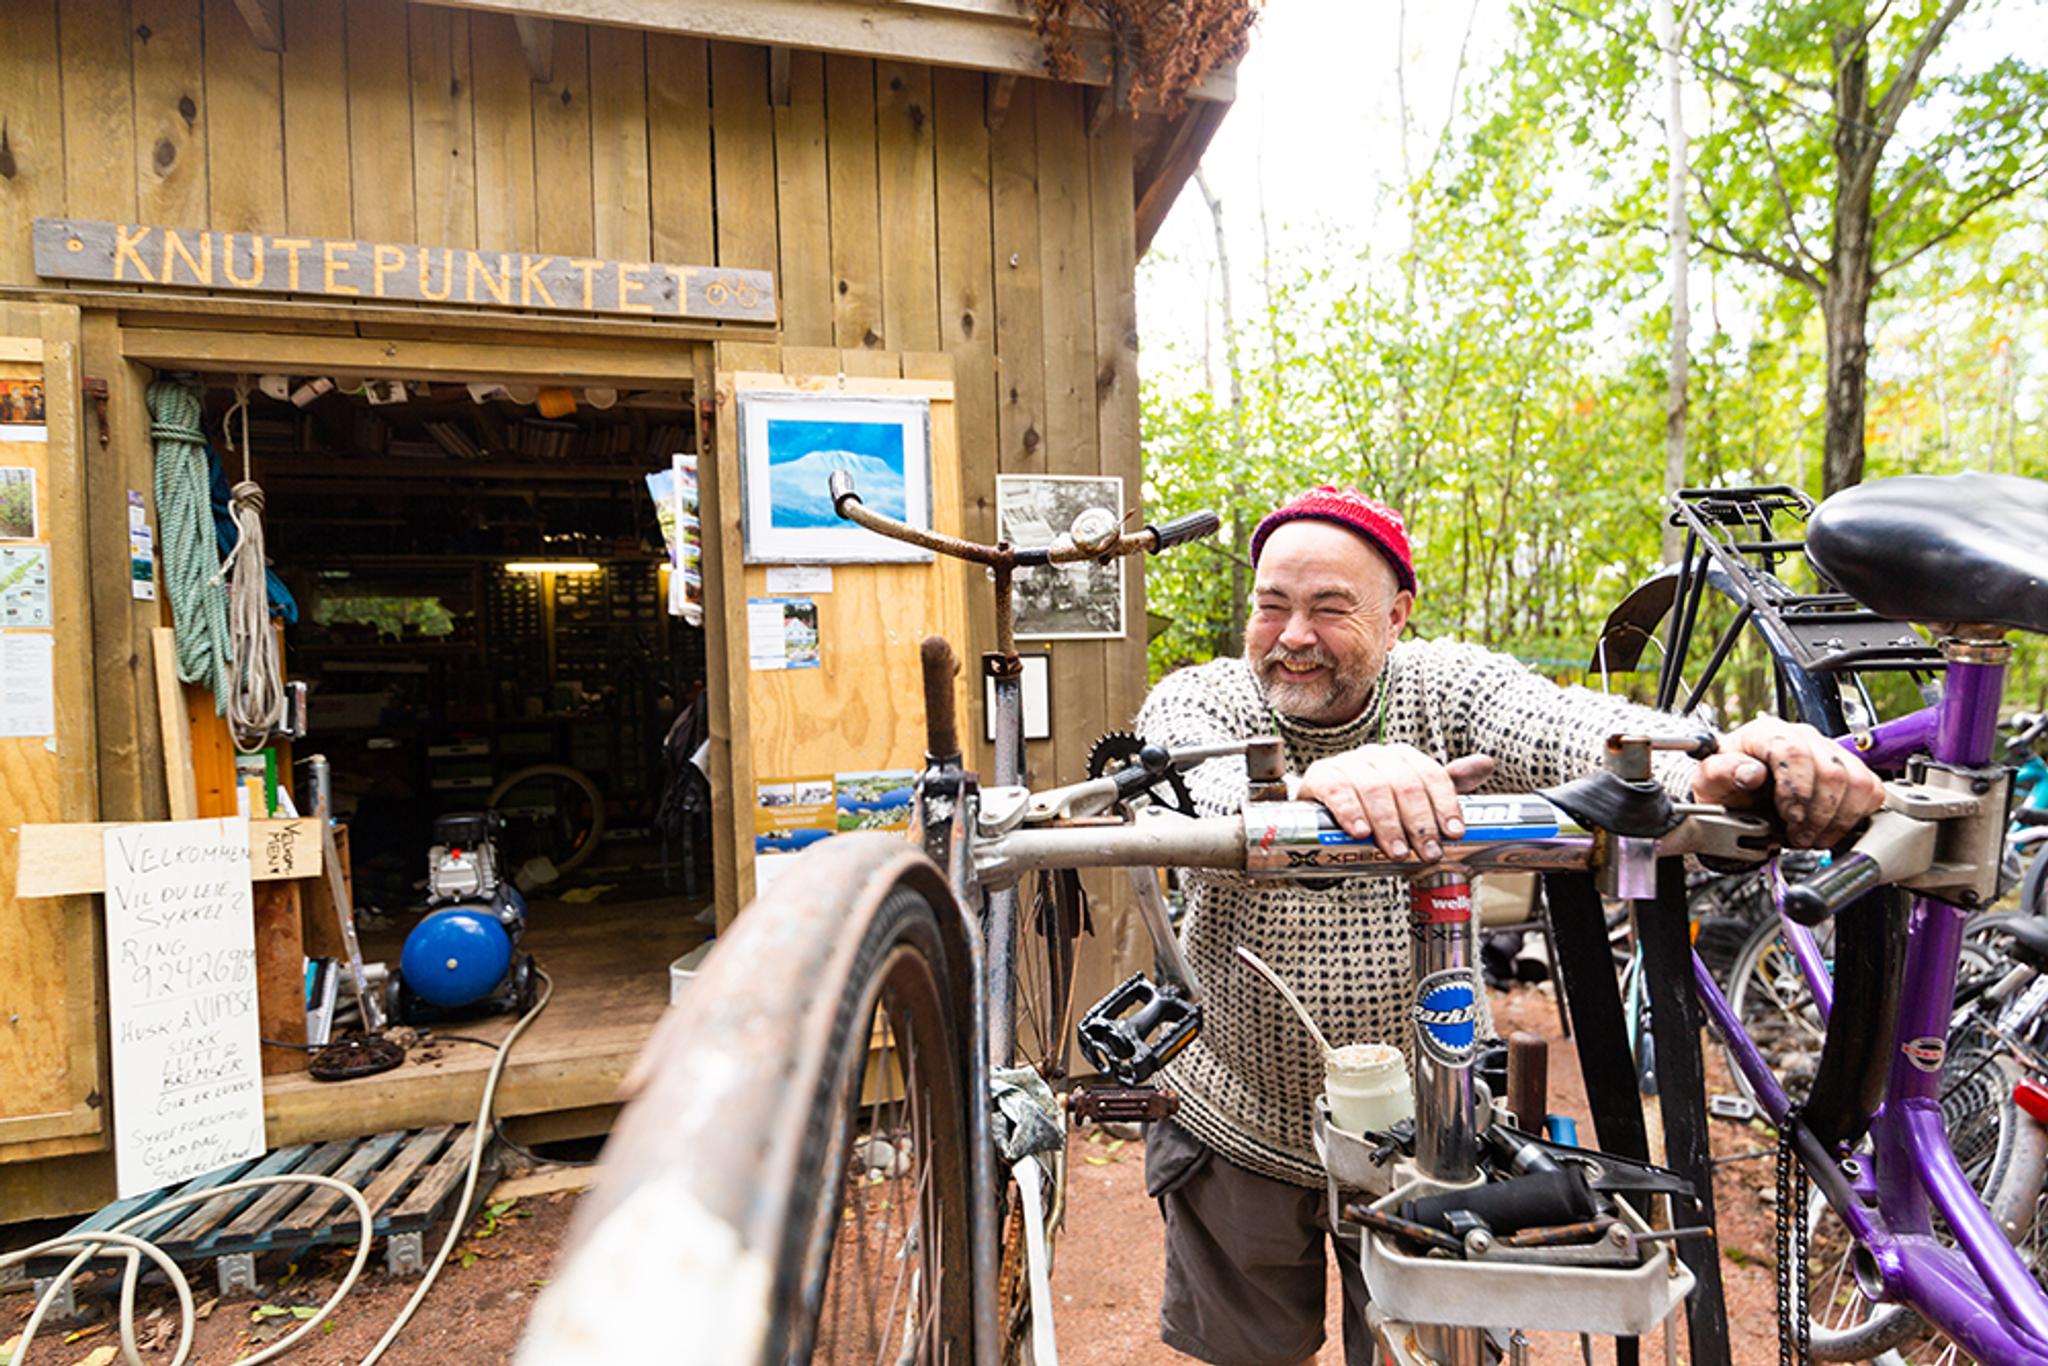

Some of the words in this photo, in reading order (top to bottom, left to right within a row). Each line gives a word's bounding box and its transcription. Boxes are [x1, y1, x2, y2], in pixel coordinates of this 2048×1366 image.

[113, 224, 700, 316] KNUTEPUNKTET
[118, 832, 252, 873] VELKOMMEN
[115, 879, 152, 910] VIL
[161, 886, 188, 903] DU
[121, 938, 186, 966] RING
[120, 1019, 173, 1044] HUSK
